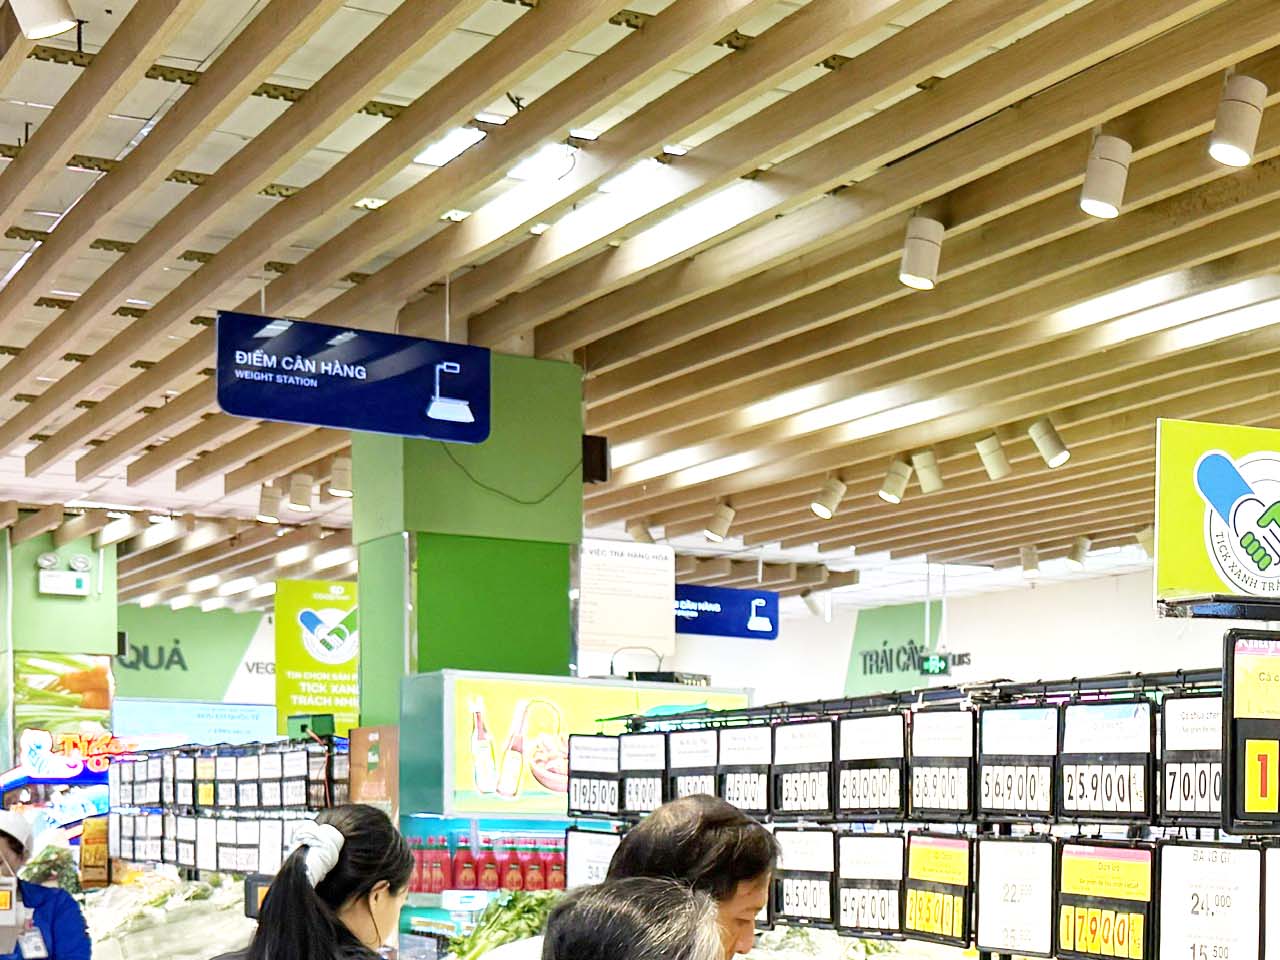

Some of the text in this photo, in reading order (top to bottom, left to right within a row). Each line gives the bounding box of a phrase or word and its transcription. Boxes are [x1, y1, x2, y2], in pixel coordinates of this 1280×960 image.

[234, 370, 318, 387] WEIGHT STATION
[235, 350, 367, 379] ĐIỂM CÂN HÀNG
[1216, 531, 1231, 562] TICK
[1228, 561, 1259, 589] XANH
[118, 639, 188, 671] QUẢ
[860, 640, 893, 675] TRÁI
[984, 772, 1036, 801] 56.900
[1067, 772, 1125, 803] 25.900
[1065, 914, 1126, 947] 17.900
